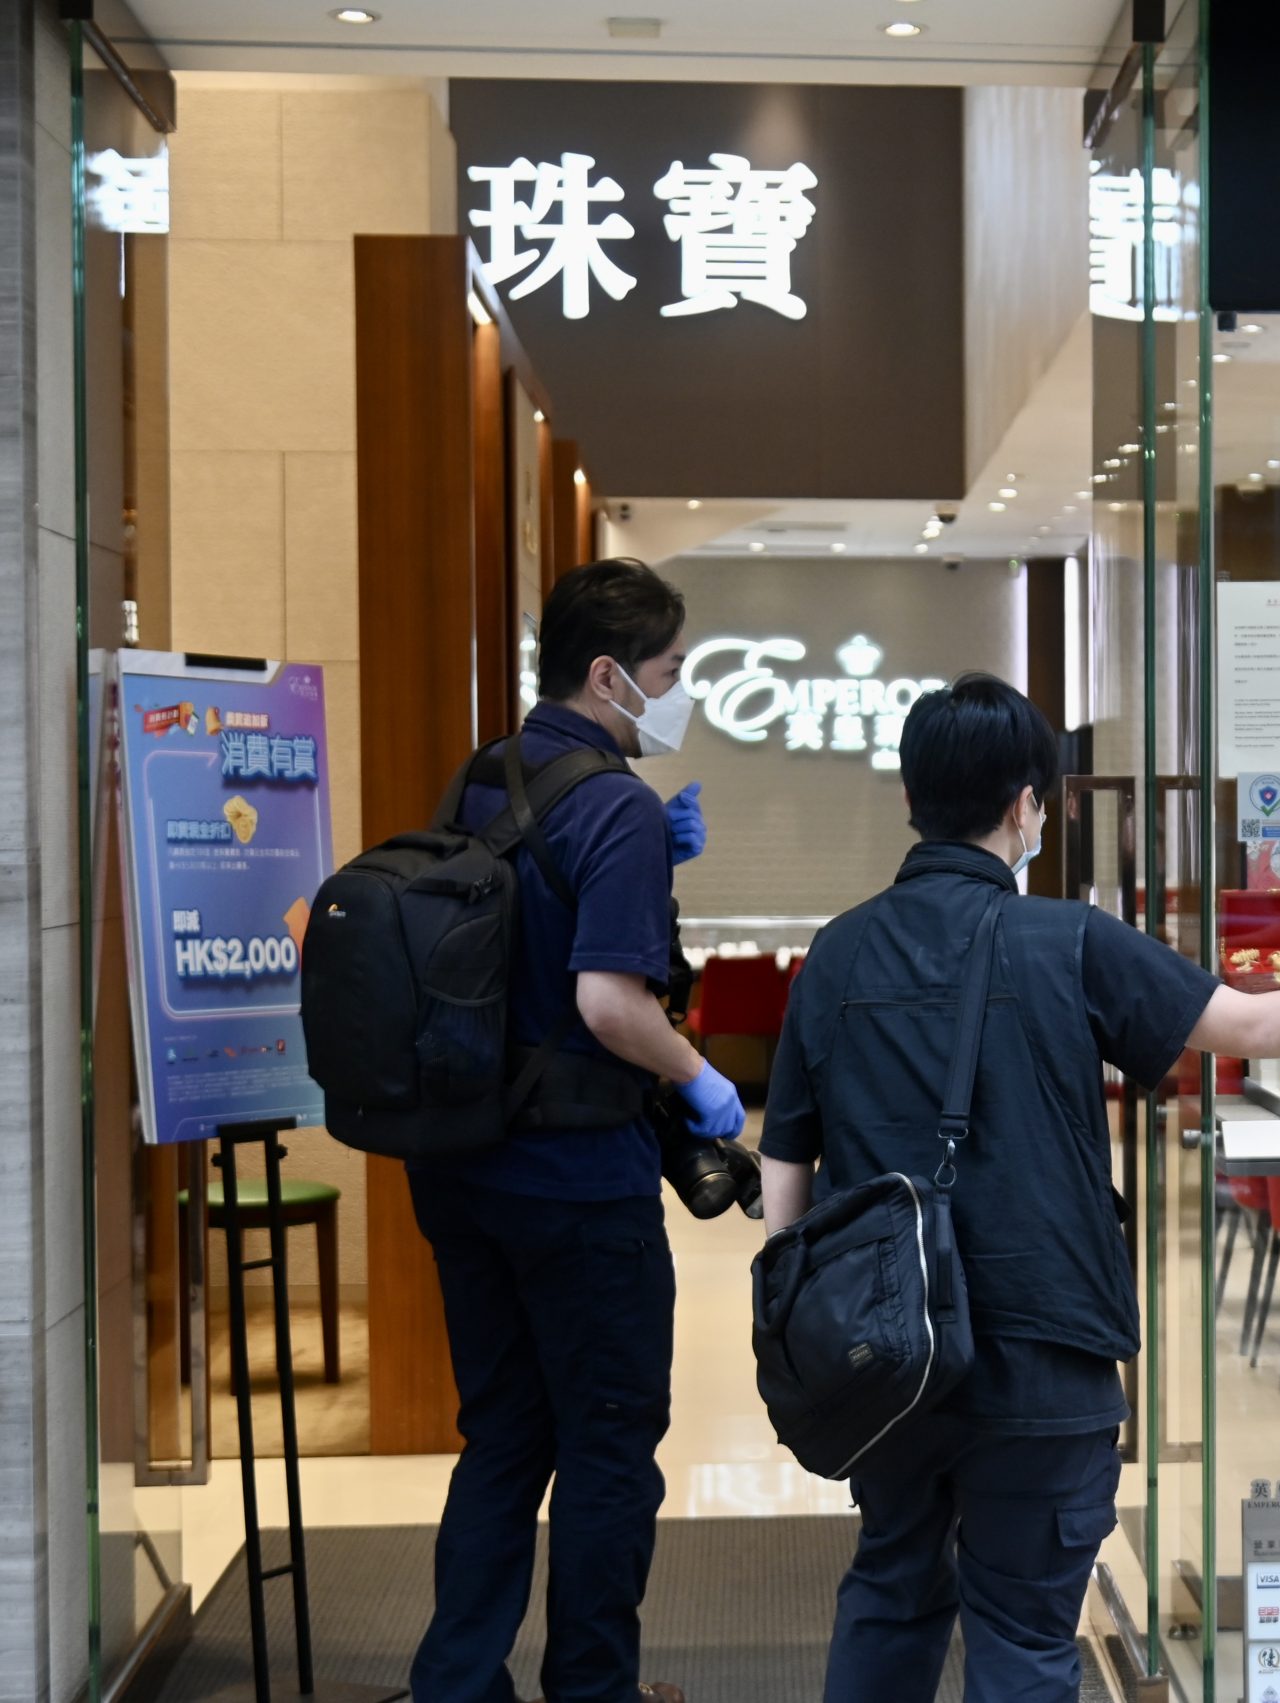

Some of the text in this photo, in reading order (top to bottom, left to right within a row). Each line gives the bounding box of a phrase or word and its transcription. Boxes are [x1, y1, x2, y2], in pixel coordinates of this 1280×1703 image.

[467, 152, 819, 320] 珠寶
[680, 637, 948, 743] EMPERO
[221, 731, 318, 778] 消費有賞
[175, 936, 298, 978] HK$2,000
[1260, 1575, 1280, 1584] VISA
